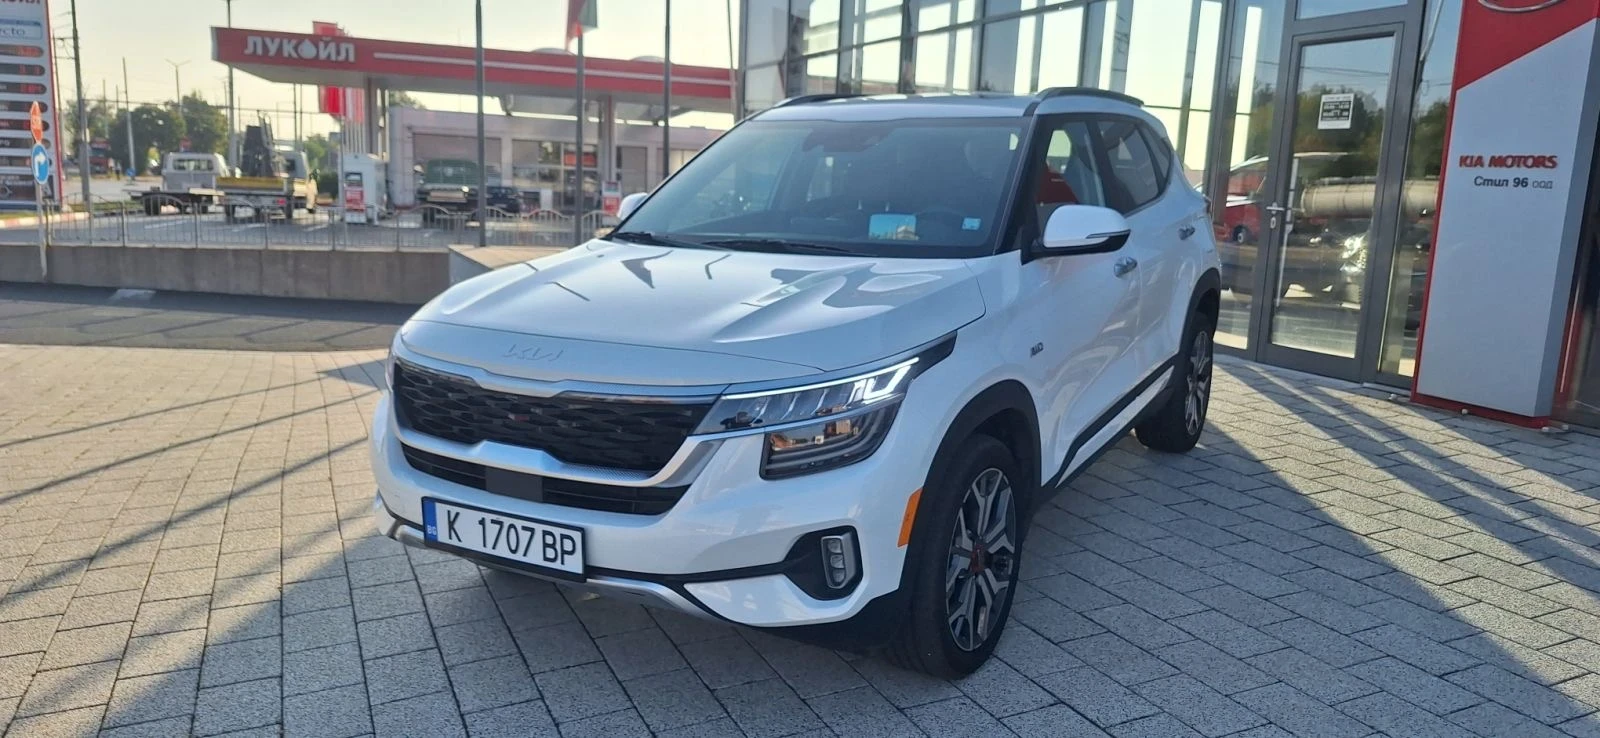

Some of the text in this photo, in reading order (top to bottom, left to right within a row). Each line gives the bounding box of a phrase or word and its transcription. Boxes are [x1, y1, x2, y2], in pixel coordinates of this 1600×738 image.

[243, 35, 356, 63] ЛУКОЙЛ
[1459, 155, 1558, 168] KIA MOTORS
[1513, 177, 1529, 188] 96
[447, 510, 576, 566] K 1707 BP
